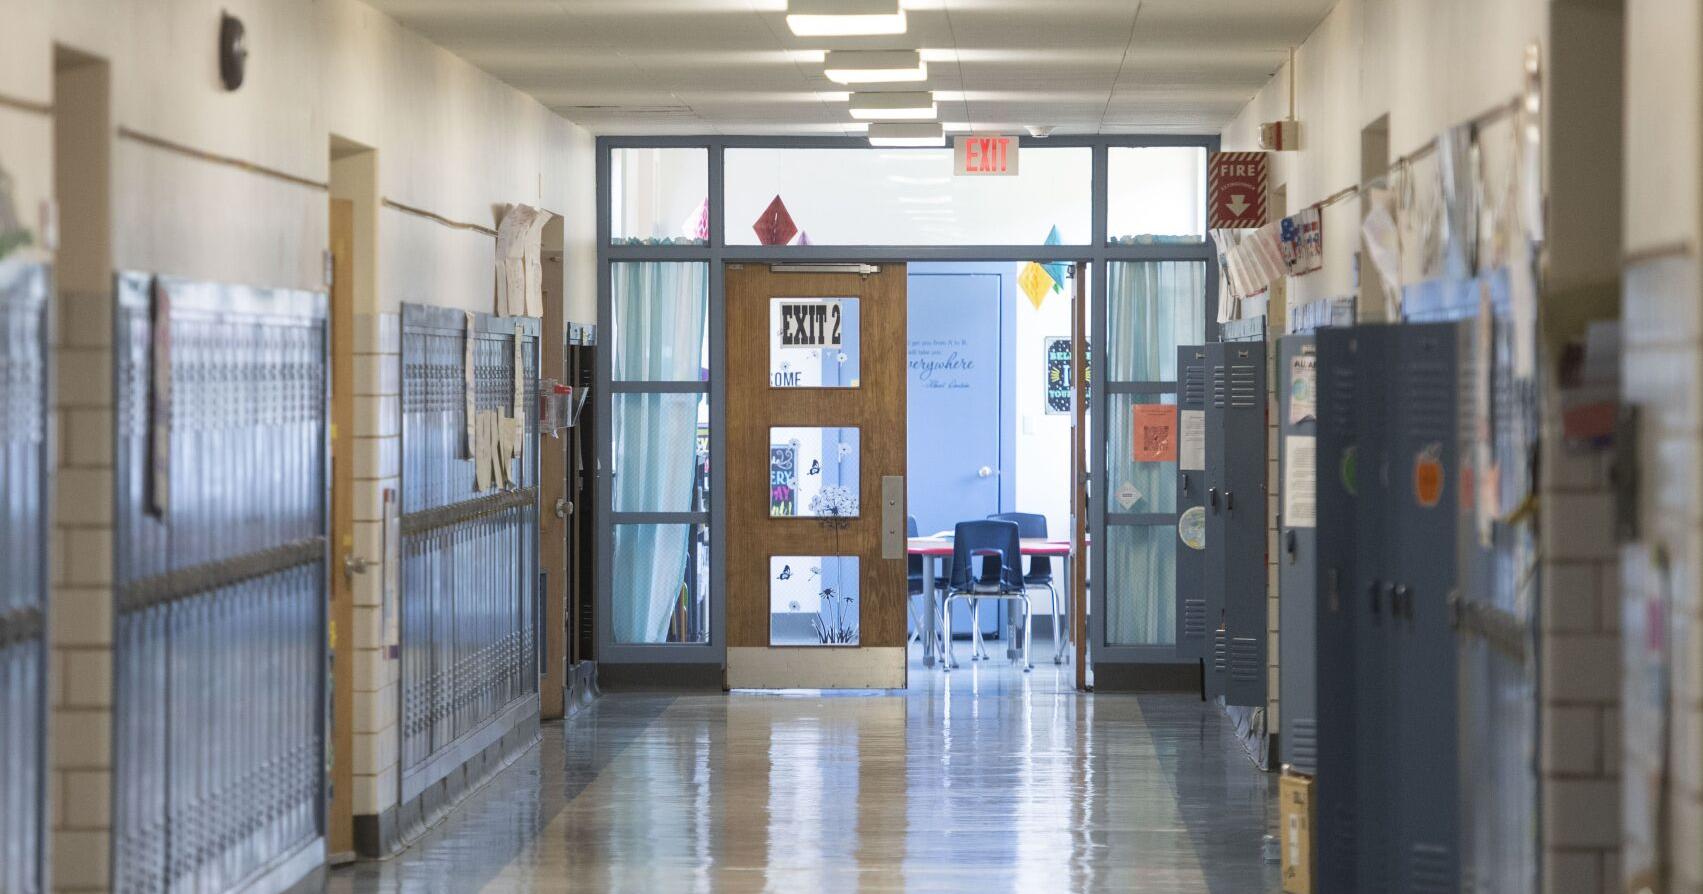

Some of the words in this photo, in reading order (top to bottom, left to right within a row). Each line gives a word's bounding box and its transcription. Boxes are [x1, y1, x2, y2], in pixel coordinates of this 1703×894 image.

[966, 138, 1009, 172] EXIT
[1221, 164, 1256, 177] FIRE
[782, 305, 827, 345] EXIT
[832, 304, 841, 345] 2
[771, 372, 802, 387] OME
